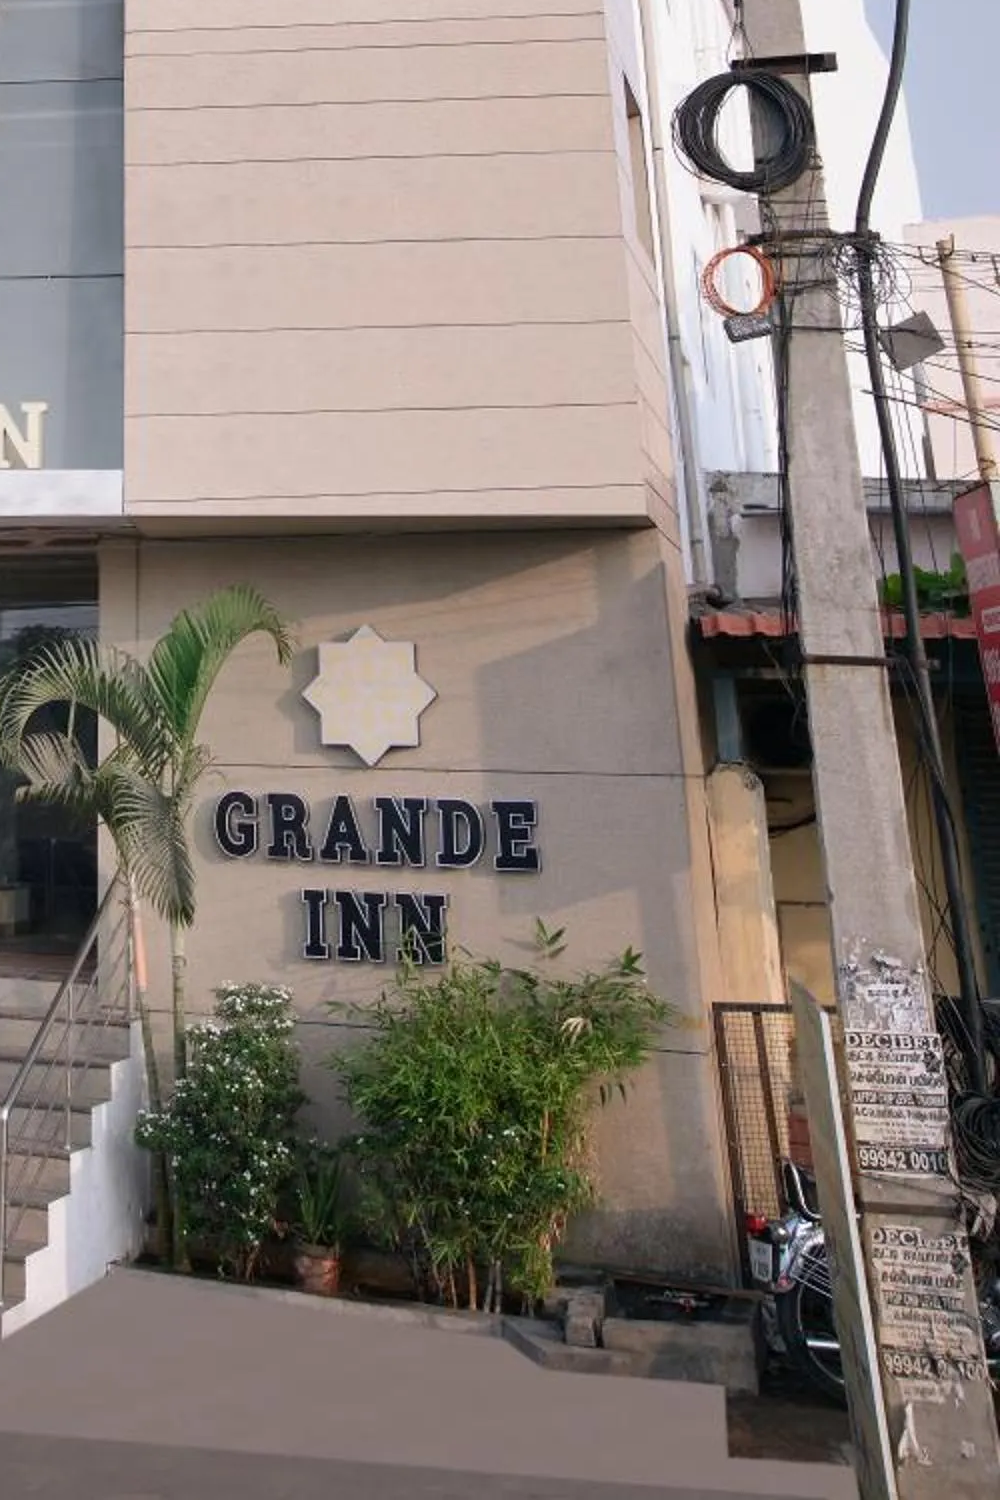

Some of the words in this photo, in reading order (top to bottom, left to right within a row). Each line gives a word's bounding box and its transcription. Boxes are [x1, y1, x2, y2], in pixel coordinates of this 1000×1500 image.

[213, 790, 541, 873] GRANDE
[300, 887, 449, 965] INN
[846, 1032, 941, 1051] DECIBEL
[859, 1148, 907, 1169] 99942
[883, 1352, 935, 1378] 99942
